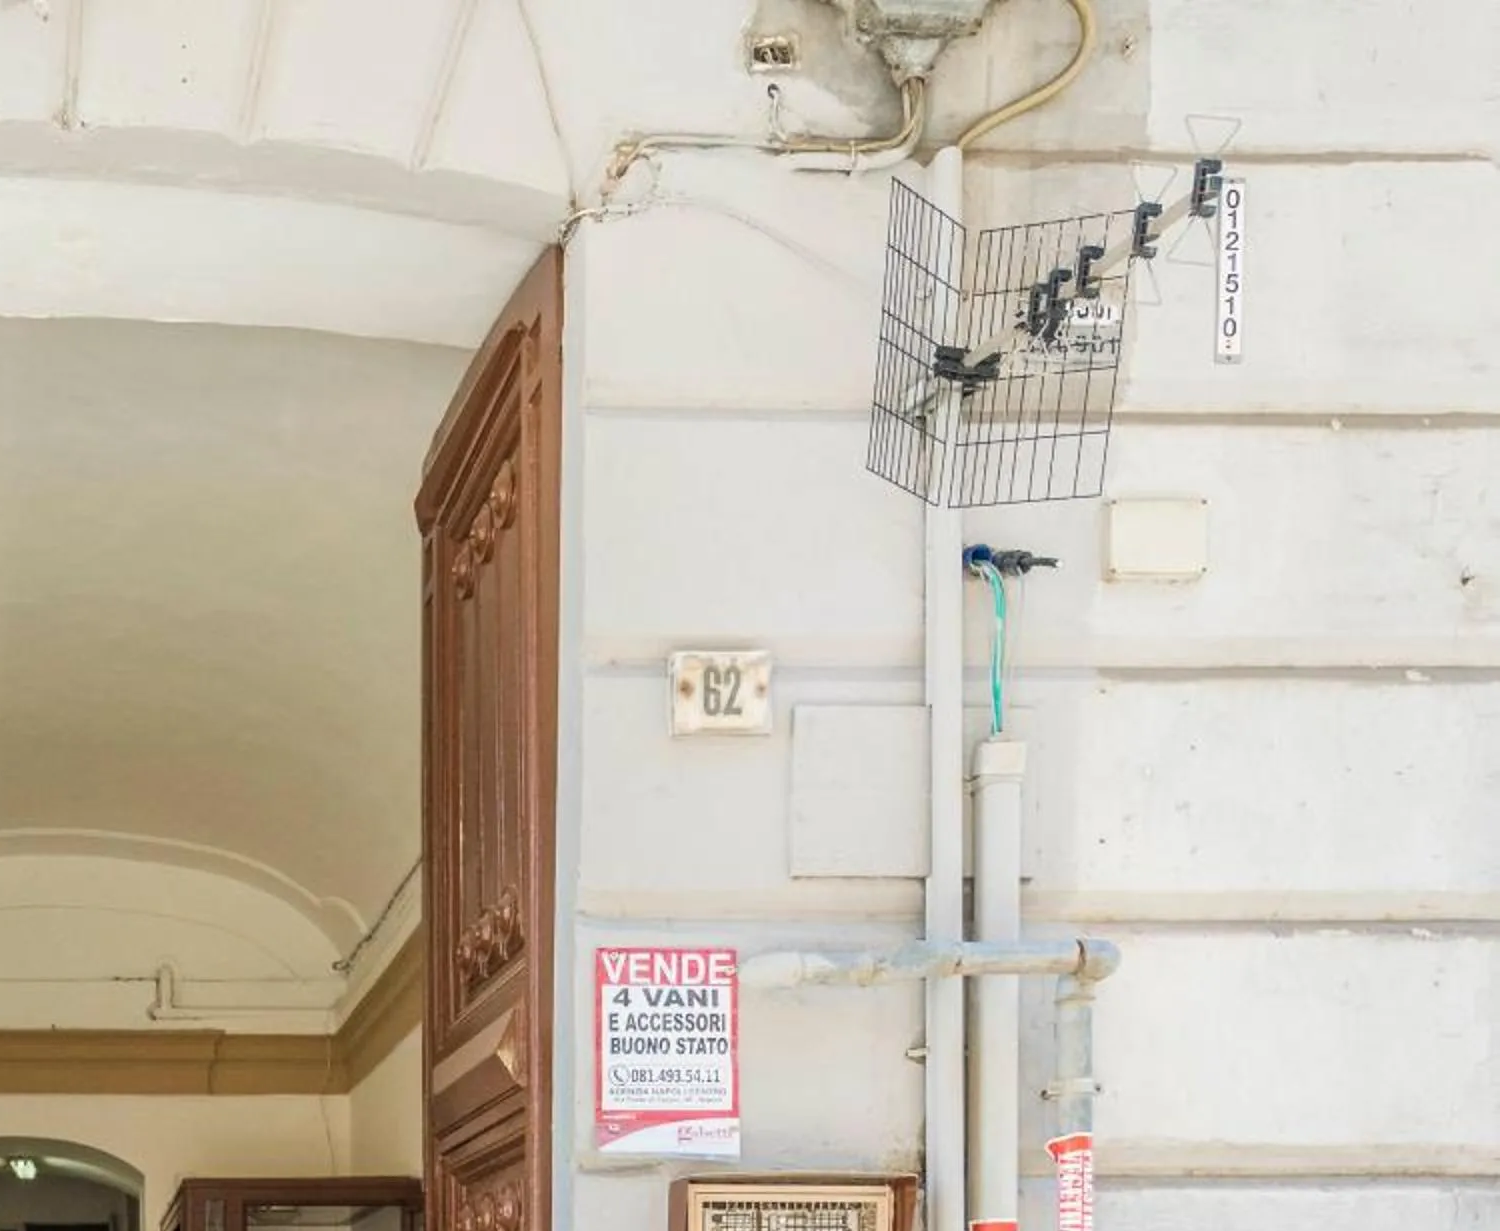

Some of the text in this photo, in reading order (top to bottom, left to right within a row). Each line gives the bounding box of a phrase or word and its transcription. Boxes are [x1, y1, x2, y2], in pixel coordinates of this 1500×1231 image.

[703, 665, 743, 716] 62
[602, 952, 732, 985] VENDE
[612, 988, 720, 1007] 4 VANI
[609, 1013, 726, 1032] E ACCESSORI
[610, 1037, 729, 1055] BUONO STATO
